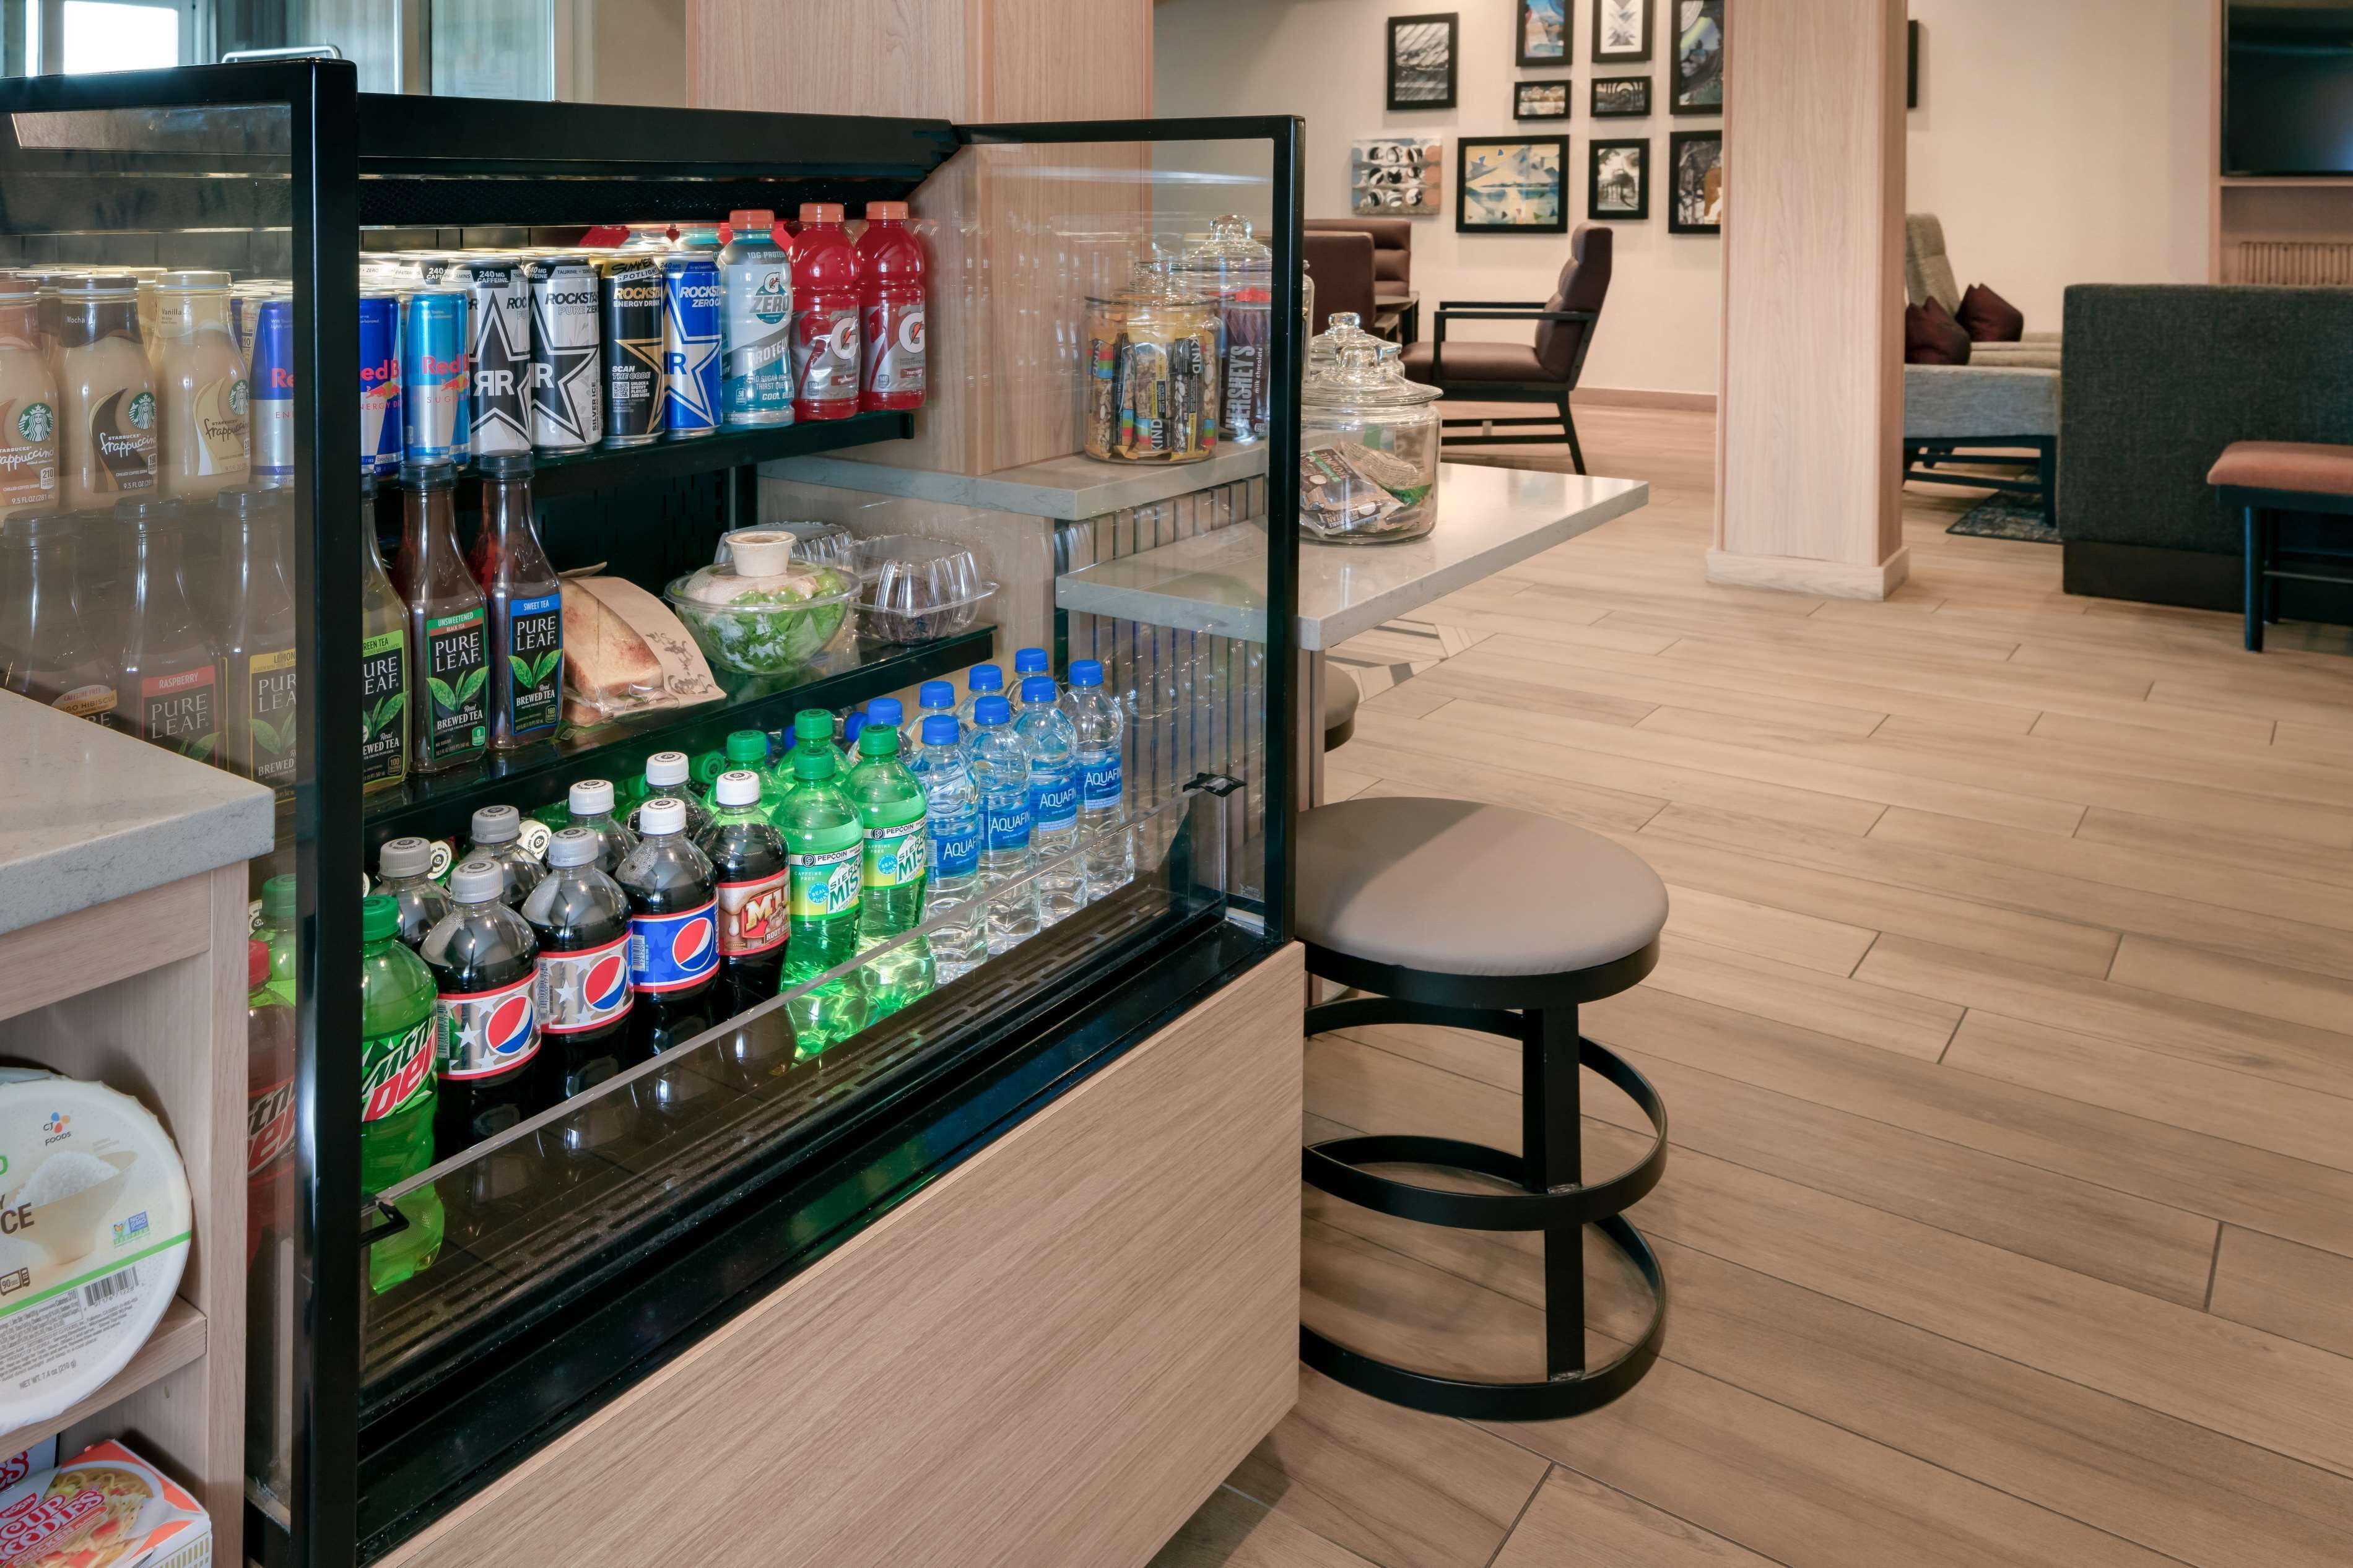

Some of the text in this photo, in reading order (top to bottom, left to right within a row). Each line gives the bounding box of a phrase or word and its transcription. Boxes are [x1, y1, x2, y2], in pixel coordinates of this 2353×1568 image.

[611, 257, 655, 275] SUMMER
[559, 306, 585, 315] PURE
[692, 299, 714, 307] ZERO
[749, 295, 789, 313] ZERO
[830, 317, 858, 360] G
[899, 312, 924, 353] G
[422, 354, 459, 375] Red
[1190, 337, 1201, 374] KIND
[271, 368, 294, 388] Re
[361, 359, 388, 381] ed
[783, 391, 793, 399] BLUE
[1225, 345, 1255, 429] HERSHEY'S
[1151, 418, 1163, 450] KIND
[43, 469, 53, 479] 210
[524, 600, 549, 611] SWEET TEA
[438, 612, 474, 627] UNSWEETENED
[516, 616, 556, 636] PURE
[363, 637, 389, 651] REEN TEA
[435, 631, 479, 656] PURE
[516, 631, 556, 651] LEAF
[274, 651, 295, 664] LEMON
[436, 648, 480, 672] LEAF
[363, 656, 398, 678] URE
[159, 673, 198, 688] RASPBERRY
[258, 674, 296, 695] PUR
[365, 672, 398, 695] EAF
[539, 683, 550, 691] Real
[258, 691, 296, 713] LEA
[516, 689, 555, 706] BREWED TEA
[152, 693, 207, 721] PURE
[464, 704, 477, 713] Real
[152, 711, 208, 739] LEAF
[437, 709, 483, 730] BREWED TEA
[380, 732, 393, 741] Real
[363, 737, 400, 756] EWED TEA
[258, 758, 294, 776] BREWED
[390, 758, 399, 766] 100
[882, 864, 897, 873] SUGAR
[898, 839, 926, 881] MIS
[812, 889, 826, 897] REAL
[812, 892, 829, 903] SUGAR
[830, 868, 861, 912] MIS
[767, 928, 781, 940] ROOT
[43, 1122, 54, 1131] CJ
[45, 1131, 71, 1146] FOODS
[0, 1202, 35, 1234] CE
[130, 1215, 145, 1223] NON
[131, 1218, 147, 1228] GMO
[2, 1279, 11, 1289] 90
[19, 1379, 31, 1389] NET
[32, 1374, 41, 1384] WT.
[41, 1369, 51, 1379] 7.4
[0, 1495, 66, 1540] CUP
[0, 1490, 105, 1561] OODLES
